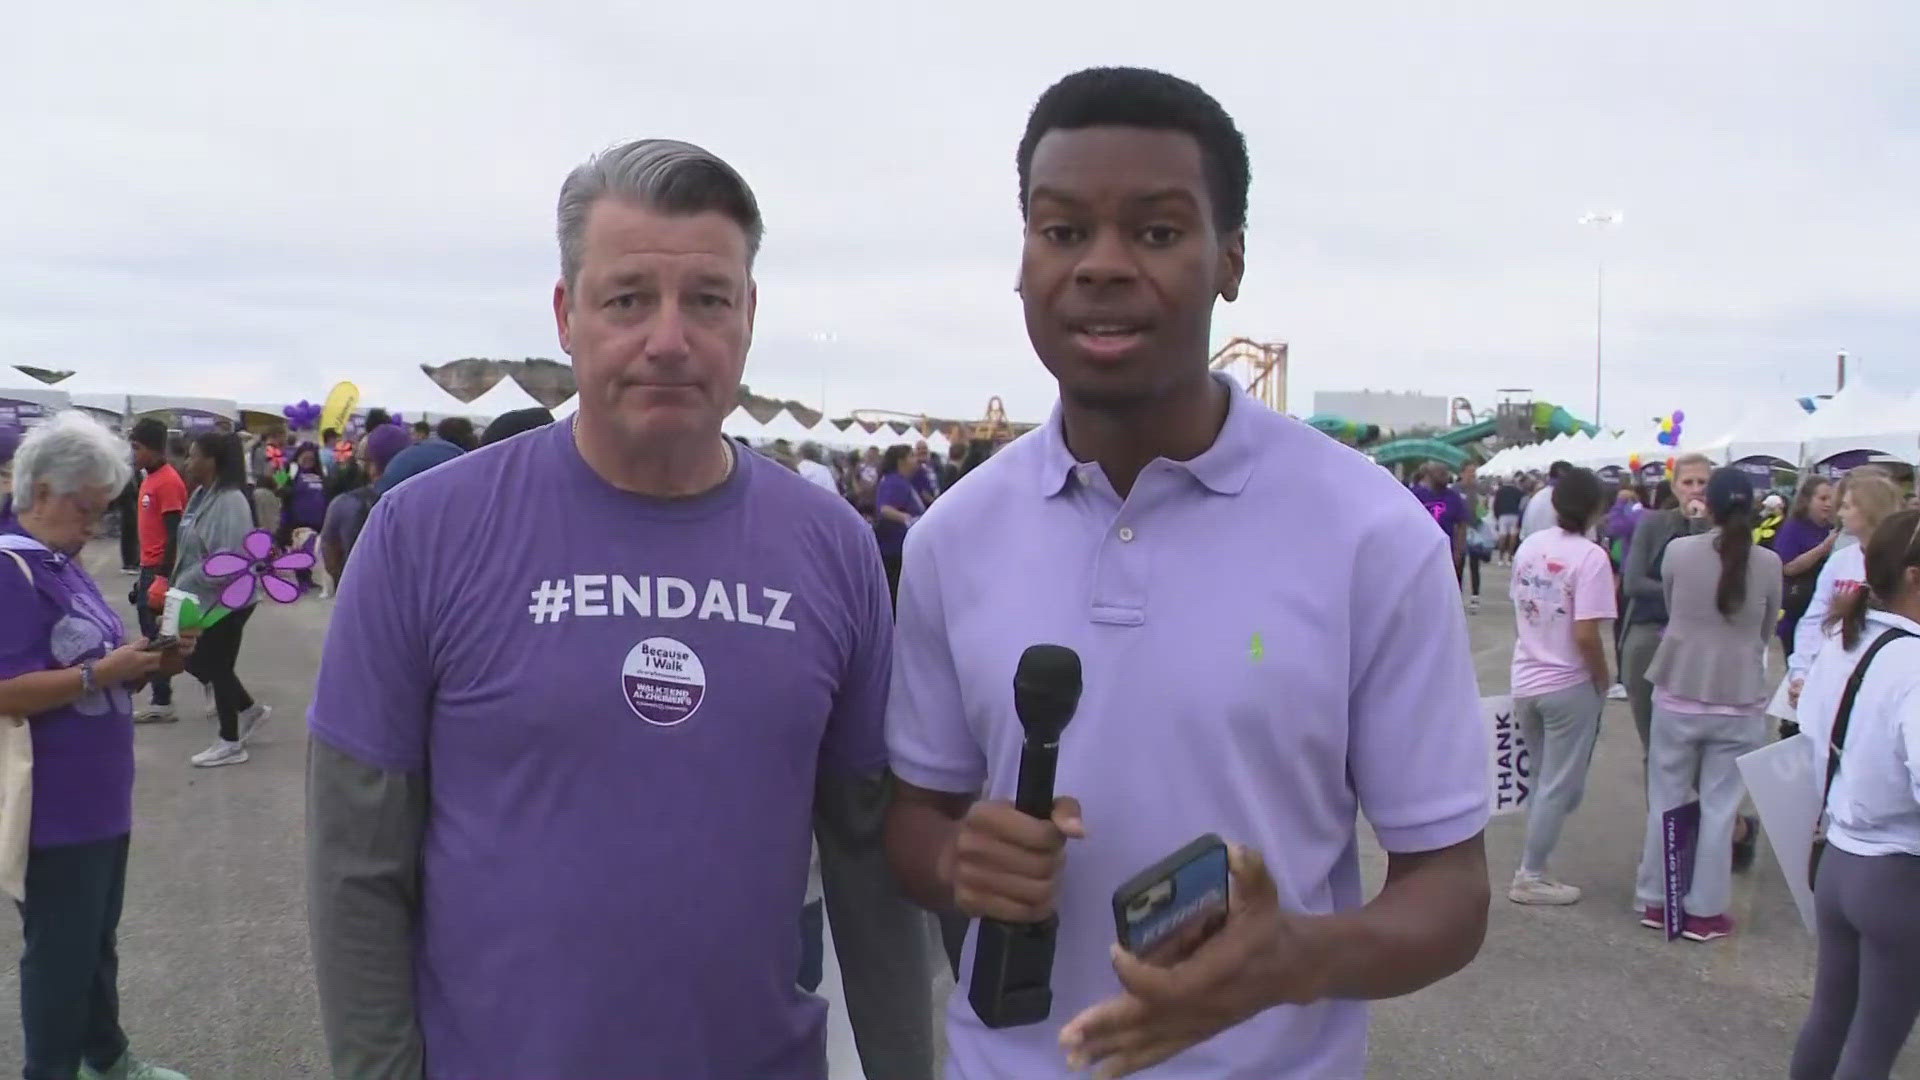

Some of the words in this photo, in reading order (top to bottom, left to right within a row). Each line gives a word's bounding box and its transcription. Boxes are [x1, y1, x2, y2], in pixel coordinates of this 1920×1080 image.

[528, 574, 796, 631] #ENDALZ
[642, 643, 689, 660] Because
[653, 657, 683, 671] Walk
[637, 683, 662, 693] WALK
[1496, 712, 1512, 810] THANK
[1515, 722, 1530, 805] YO
[1669, 853, 1677, 871] OF
[1670, 874, 1680, 932] BECAUSE
